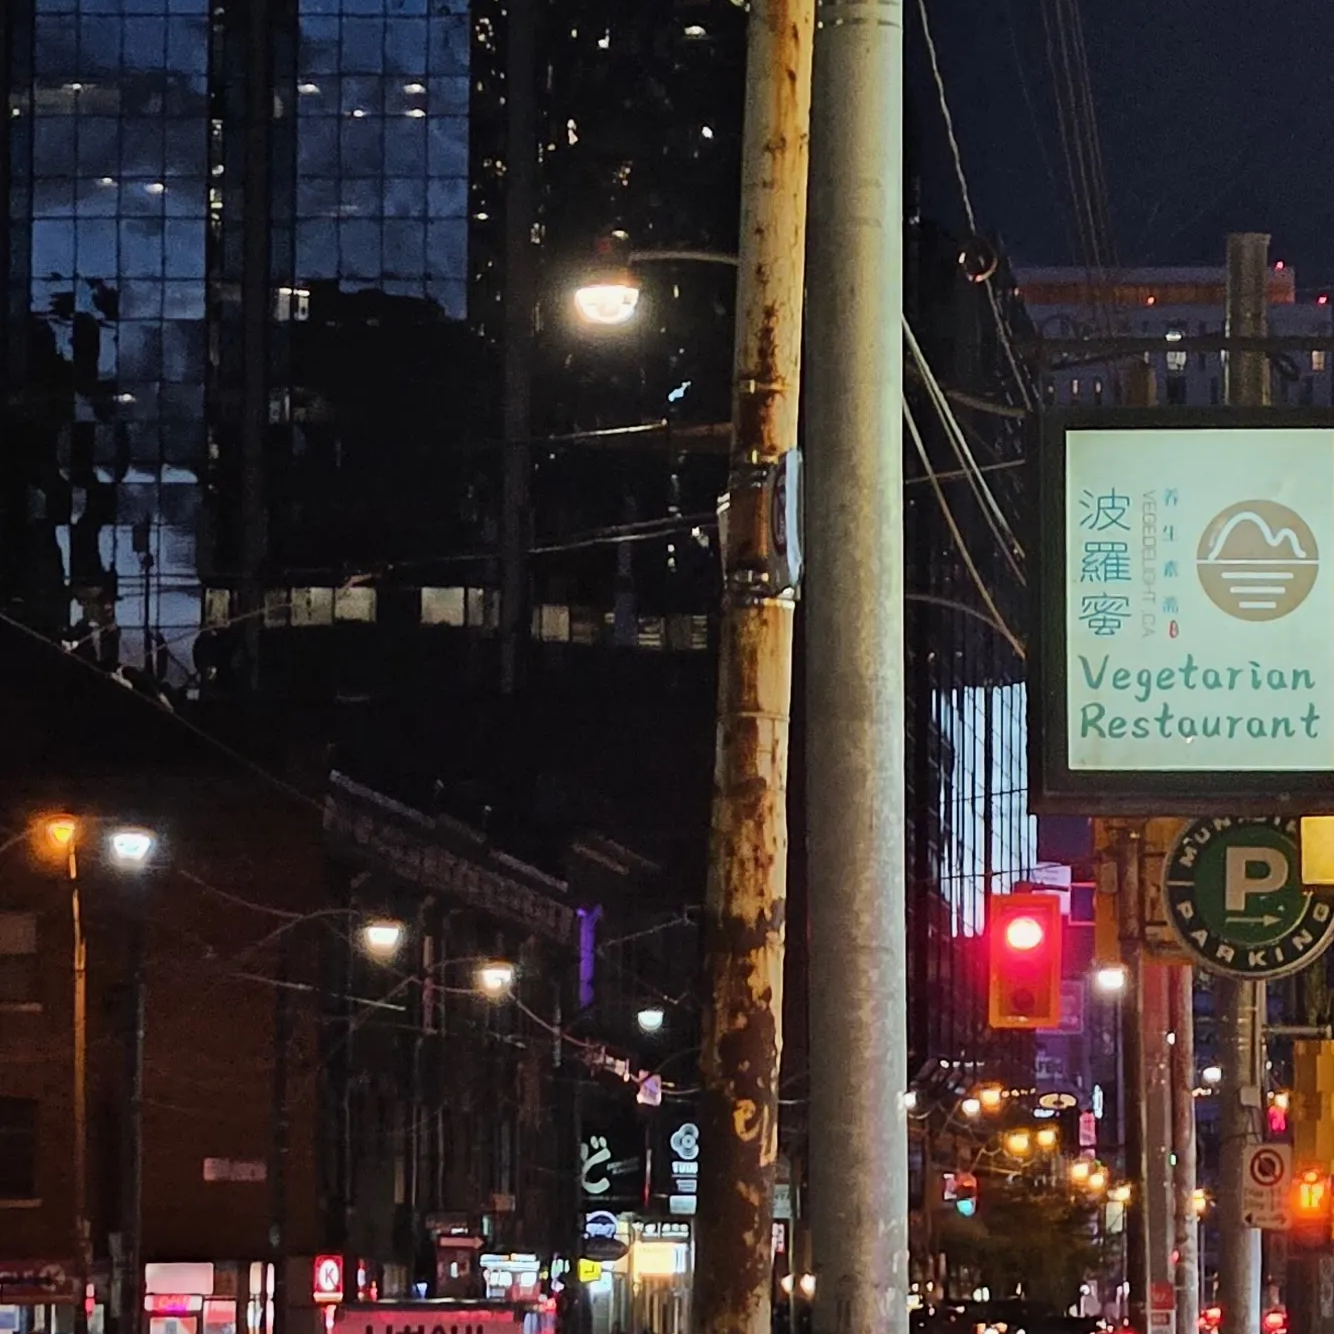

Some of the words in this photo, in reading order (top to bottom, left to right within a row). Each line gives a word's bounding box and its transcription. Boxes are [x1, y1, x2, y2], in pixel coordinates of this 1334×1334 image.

[1079, 487, 1132, 636] 波羅蜜
[1077, 652, 1316, 702] Vegetarian
[1080, 701, 1321, 740] Restaurant
[1226, 847, 1288, 910] P
[1176, 901, 1330, 966] PARKING
